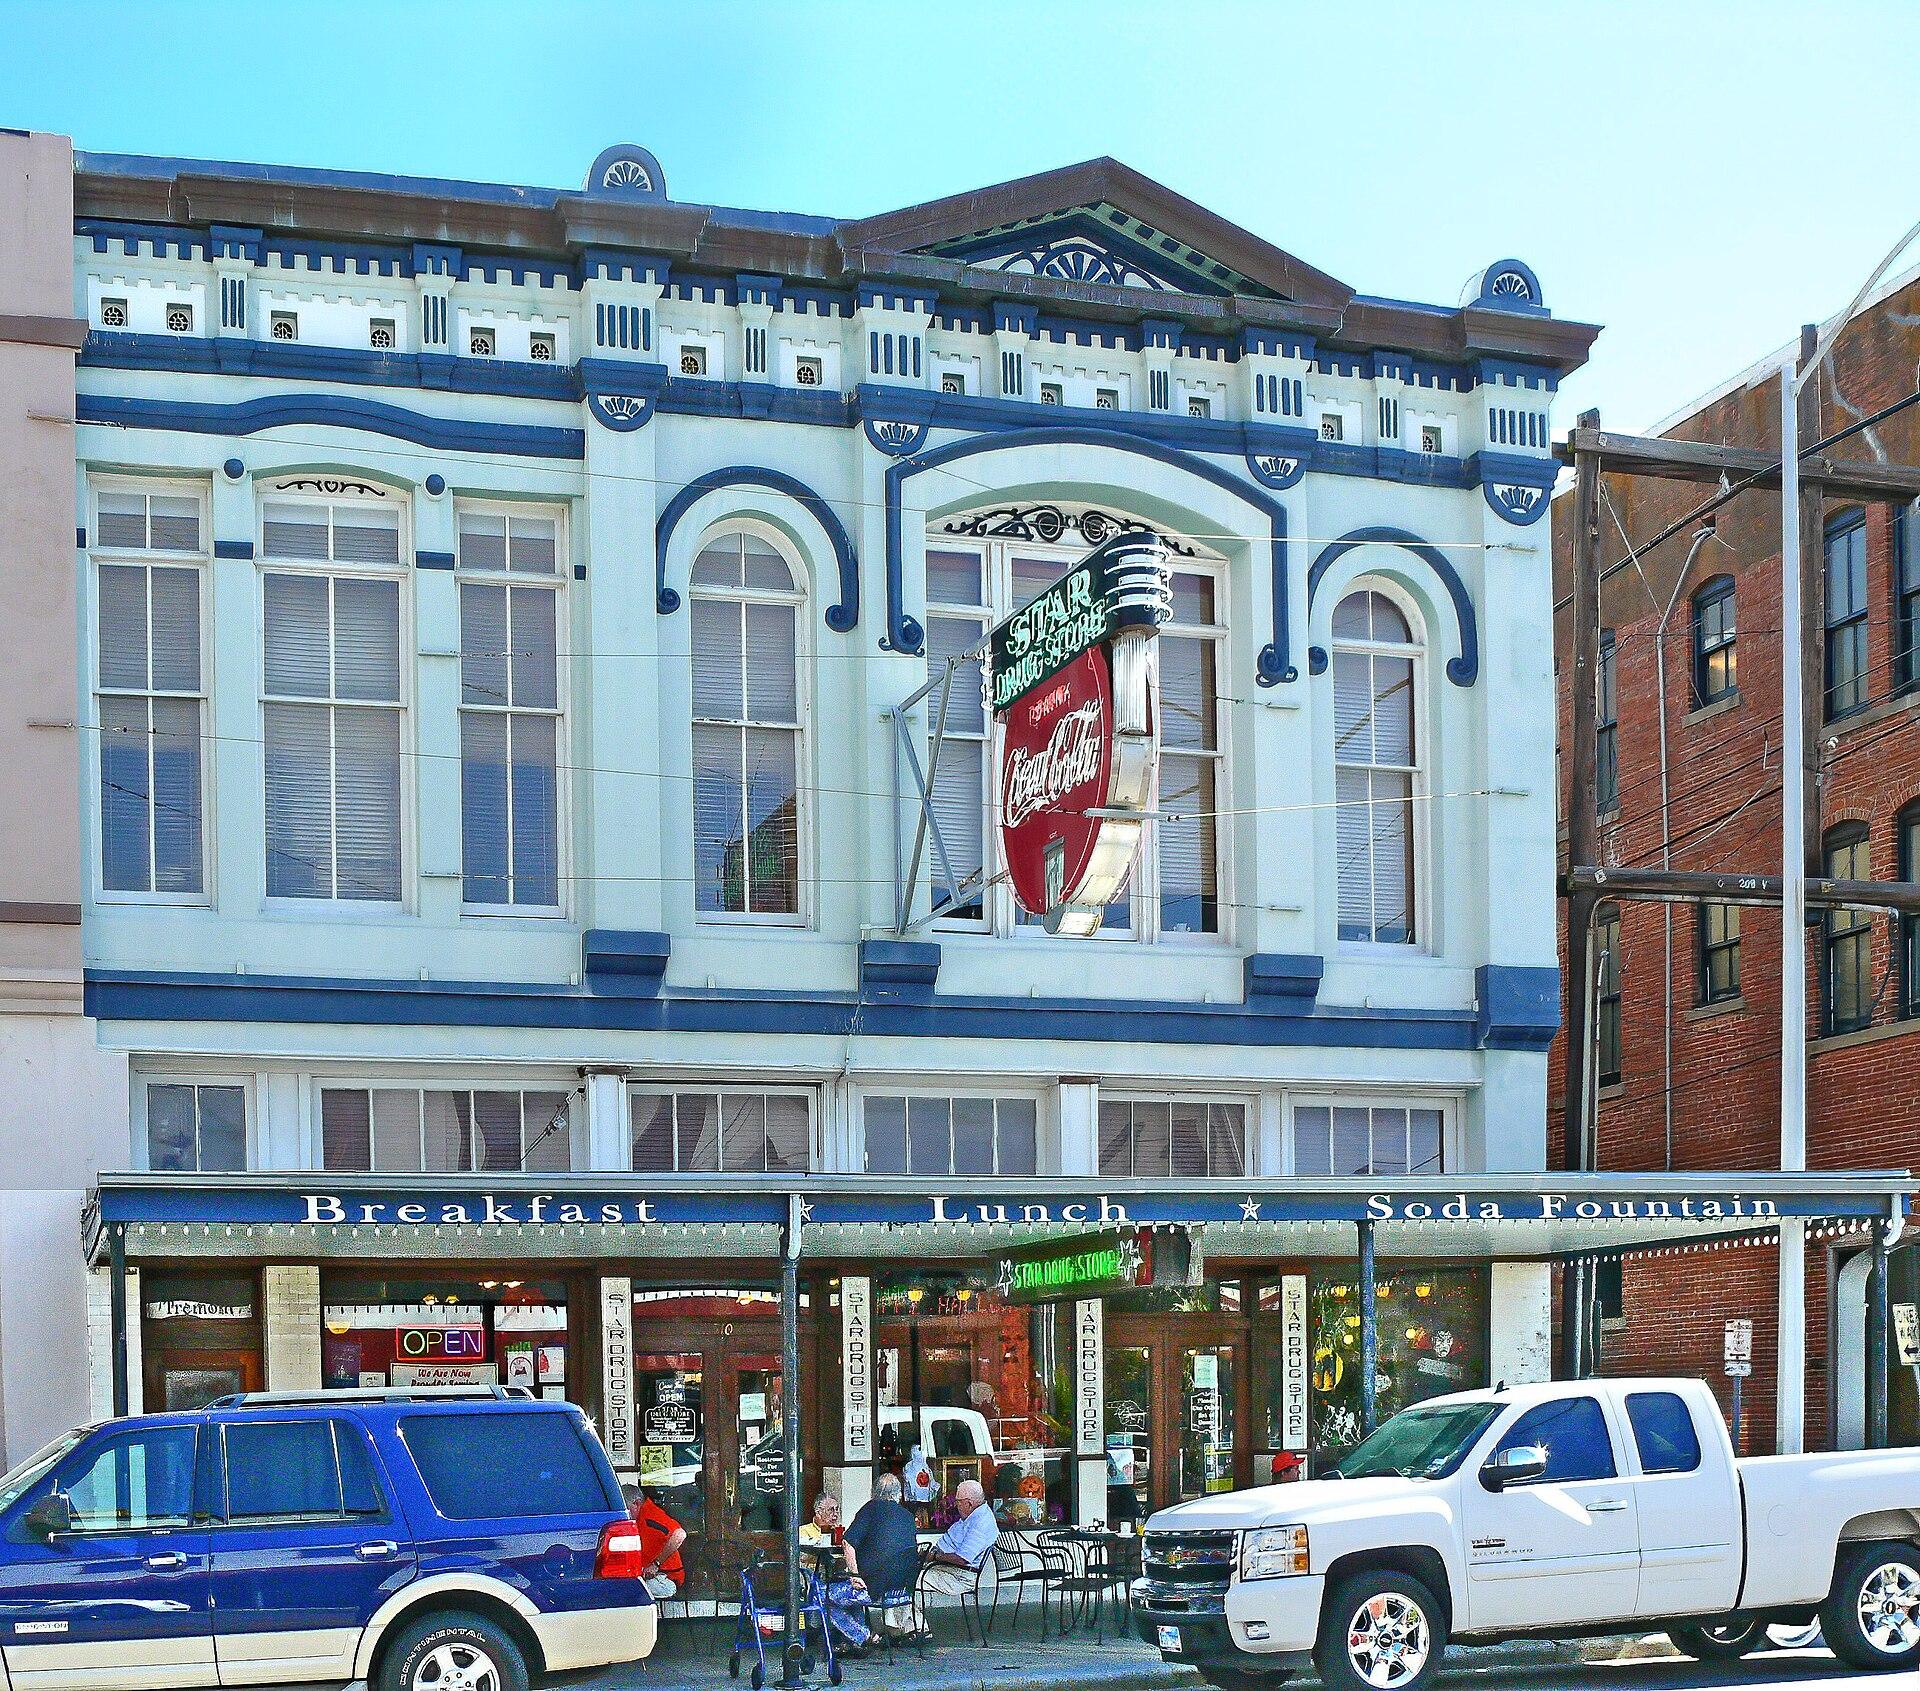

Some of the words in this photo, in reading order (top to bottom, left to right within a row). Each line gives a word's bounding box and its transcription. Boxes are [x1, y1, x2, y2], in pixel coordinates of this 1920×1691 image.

[1006, 569, 1093, 658] STAR
[993, 646, 1044, 706] DRUG
[1045, 598, 1109, 669] STORE
[300, 1195, 657, 1223] Breakfast
[927, 1195, 1130, 1223] Lunch
[1366, 1193, 1503, 1220] Soda
[1537, 1193, 1780, 1218] Fountain
[1013, 1261, 1042, 1289] STAR
[1043, 1256, 1074, 1285] DRUG
[1077, 1249, 1119, 1281] STORE
[849, 1292, 864, 1338] STAR
[1082, 1302, 1096, 1335] TAR
[1288, 1289, 1301, 1332] STAR
[403, 1330, 481, 1354] OPEN
[850, 1341, 865, 1387] DRUG
[1082, 1338, 1097, 1382] DRUG
[1288, 1336, 1302, 1378] DRUG
[417, 1368, 431, 1378] We
[432, 1368, 449, 1378] Are
[450, 1368, 471, 1378] Now
[609, 1344, 626, 1390] DRUG
[611, 1394, 627, 1452] STORE
[850, 1391, 866, 1447] STORE
[1083, 1387, 1097, 1441] STORE
[1289, 1383, 1302, 1436] STORE
[400, 1628, 486, 1686] CONTINENTAL
